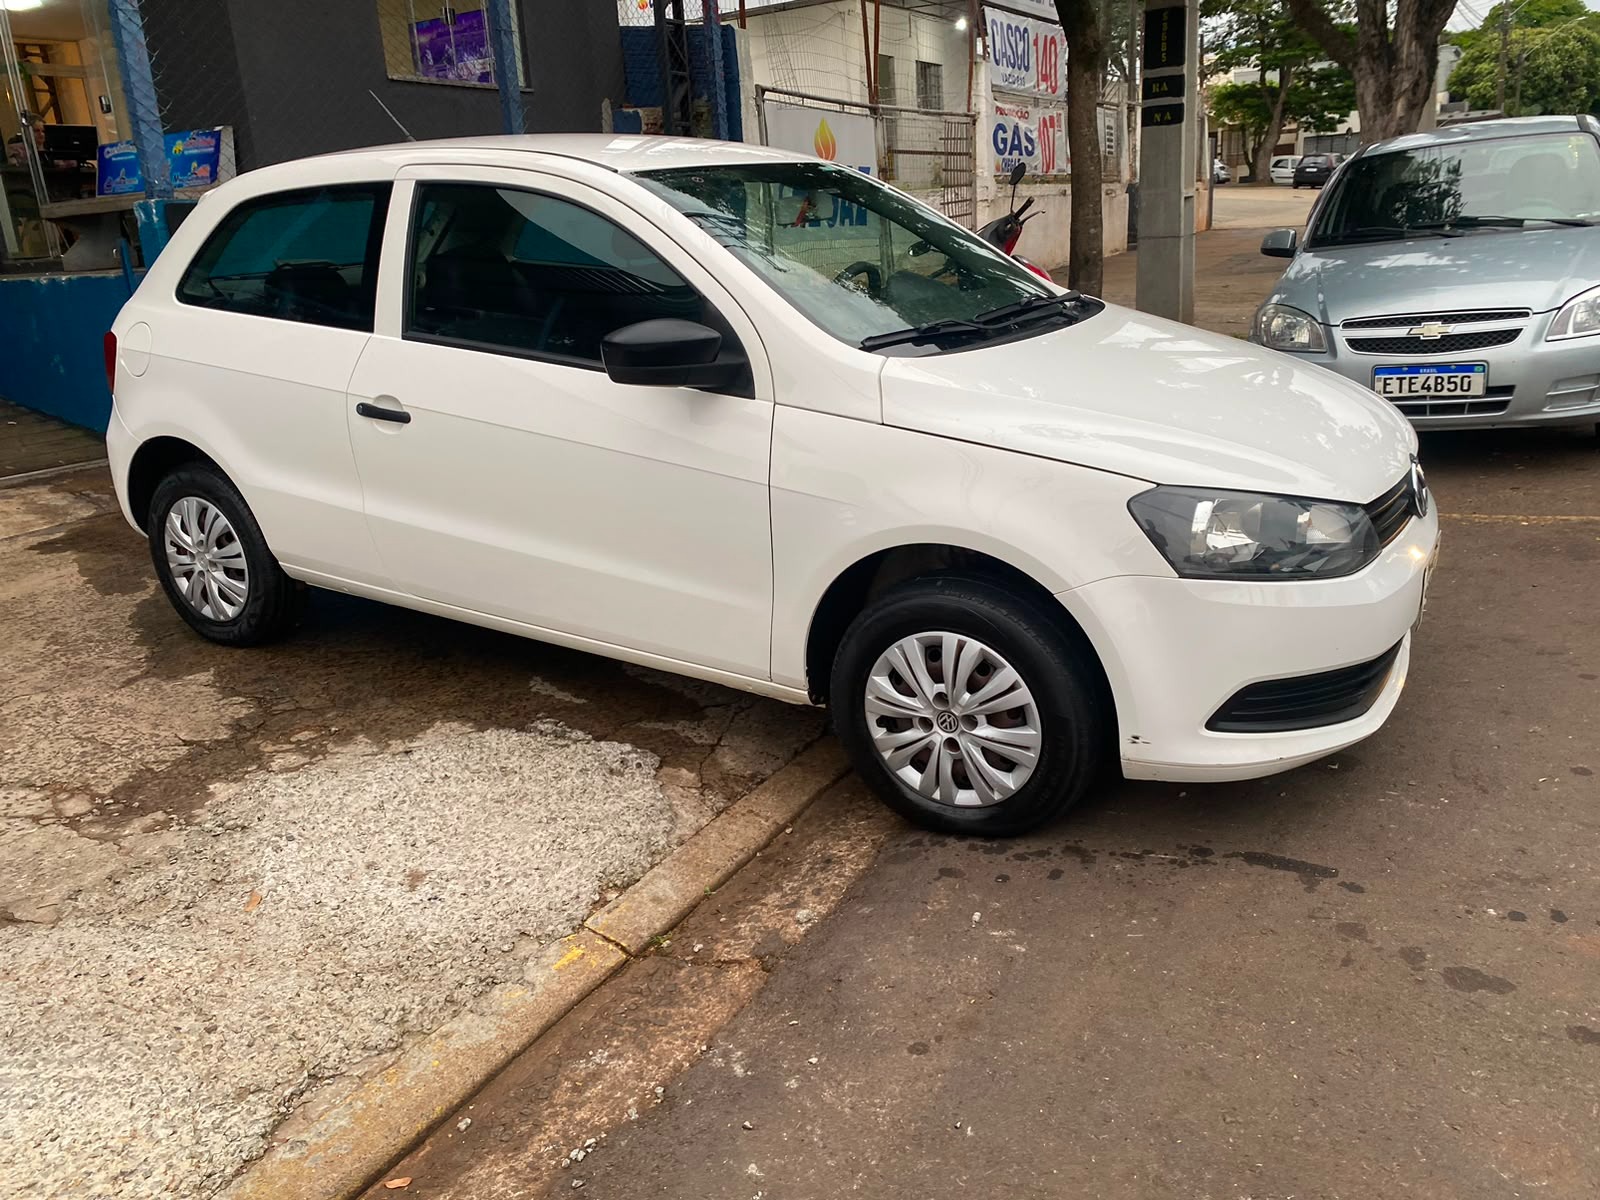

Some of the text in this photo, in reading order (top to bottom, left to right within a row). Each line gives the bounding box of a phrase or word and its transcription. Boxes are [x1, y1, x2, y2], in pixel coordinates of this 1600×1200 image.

[991, 18, 1058, 95] CASCO 140
[992, 122, 1035, 157] GÁS
[1037, 115, 1055, 174] 107
[1383, 375, 1472, 395] ETE4B50
